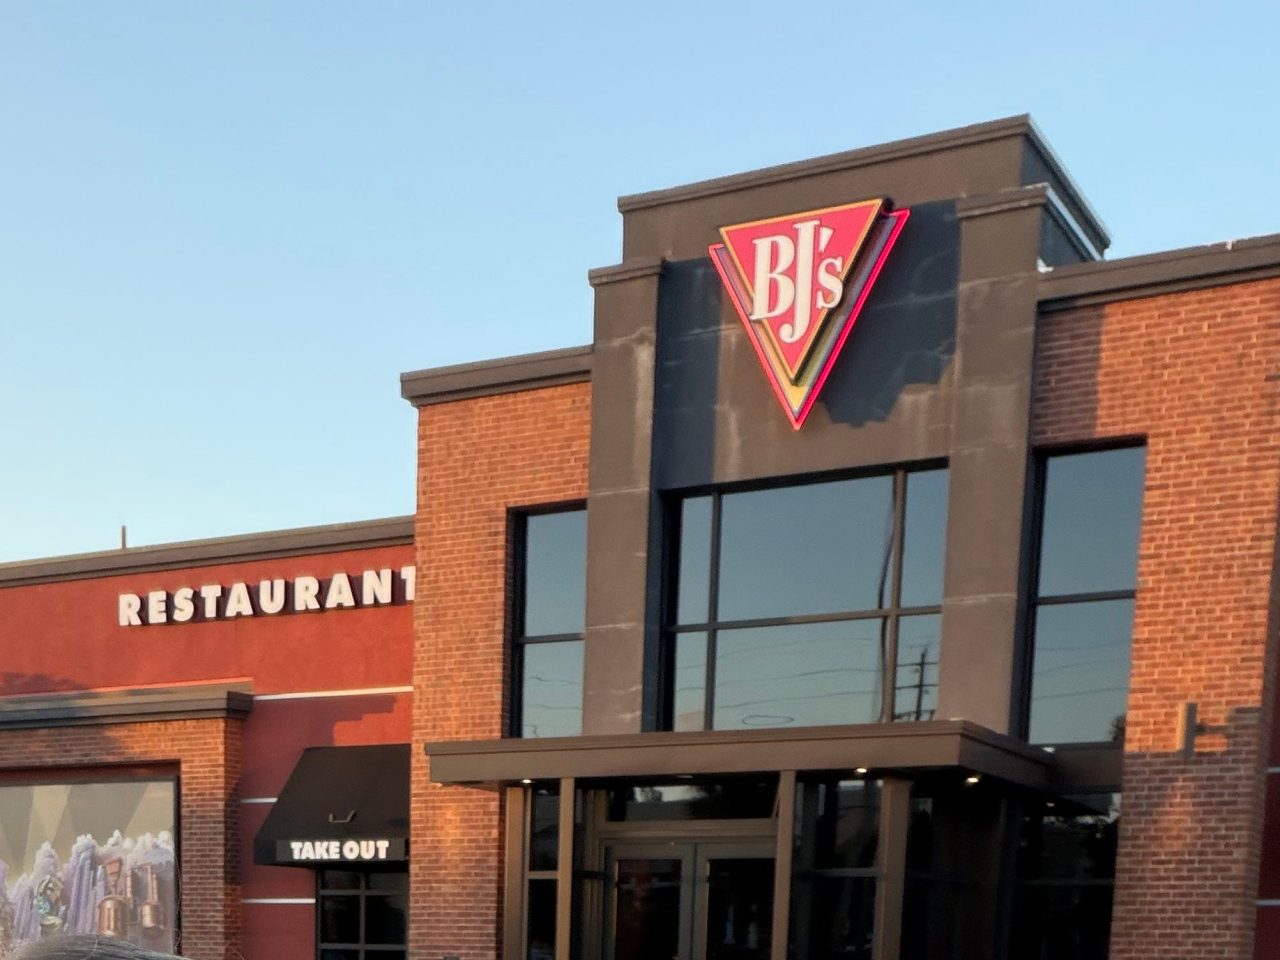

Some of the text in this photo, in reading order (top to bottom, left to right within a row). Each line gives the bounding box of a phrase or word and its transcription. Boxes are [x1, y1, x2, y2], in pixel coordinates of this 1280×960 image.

[750, 220, 843, 343] BJ's
[119, 565, 416, 626] RESTAURANT
[291, 840, 389, 860] TAKE OUT
